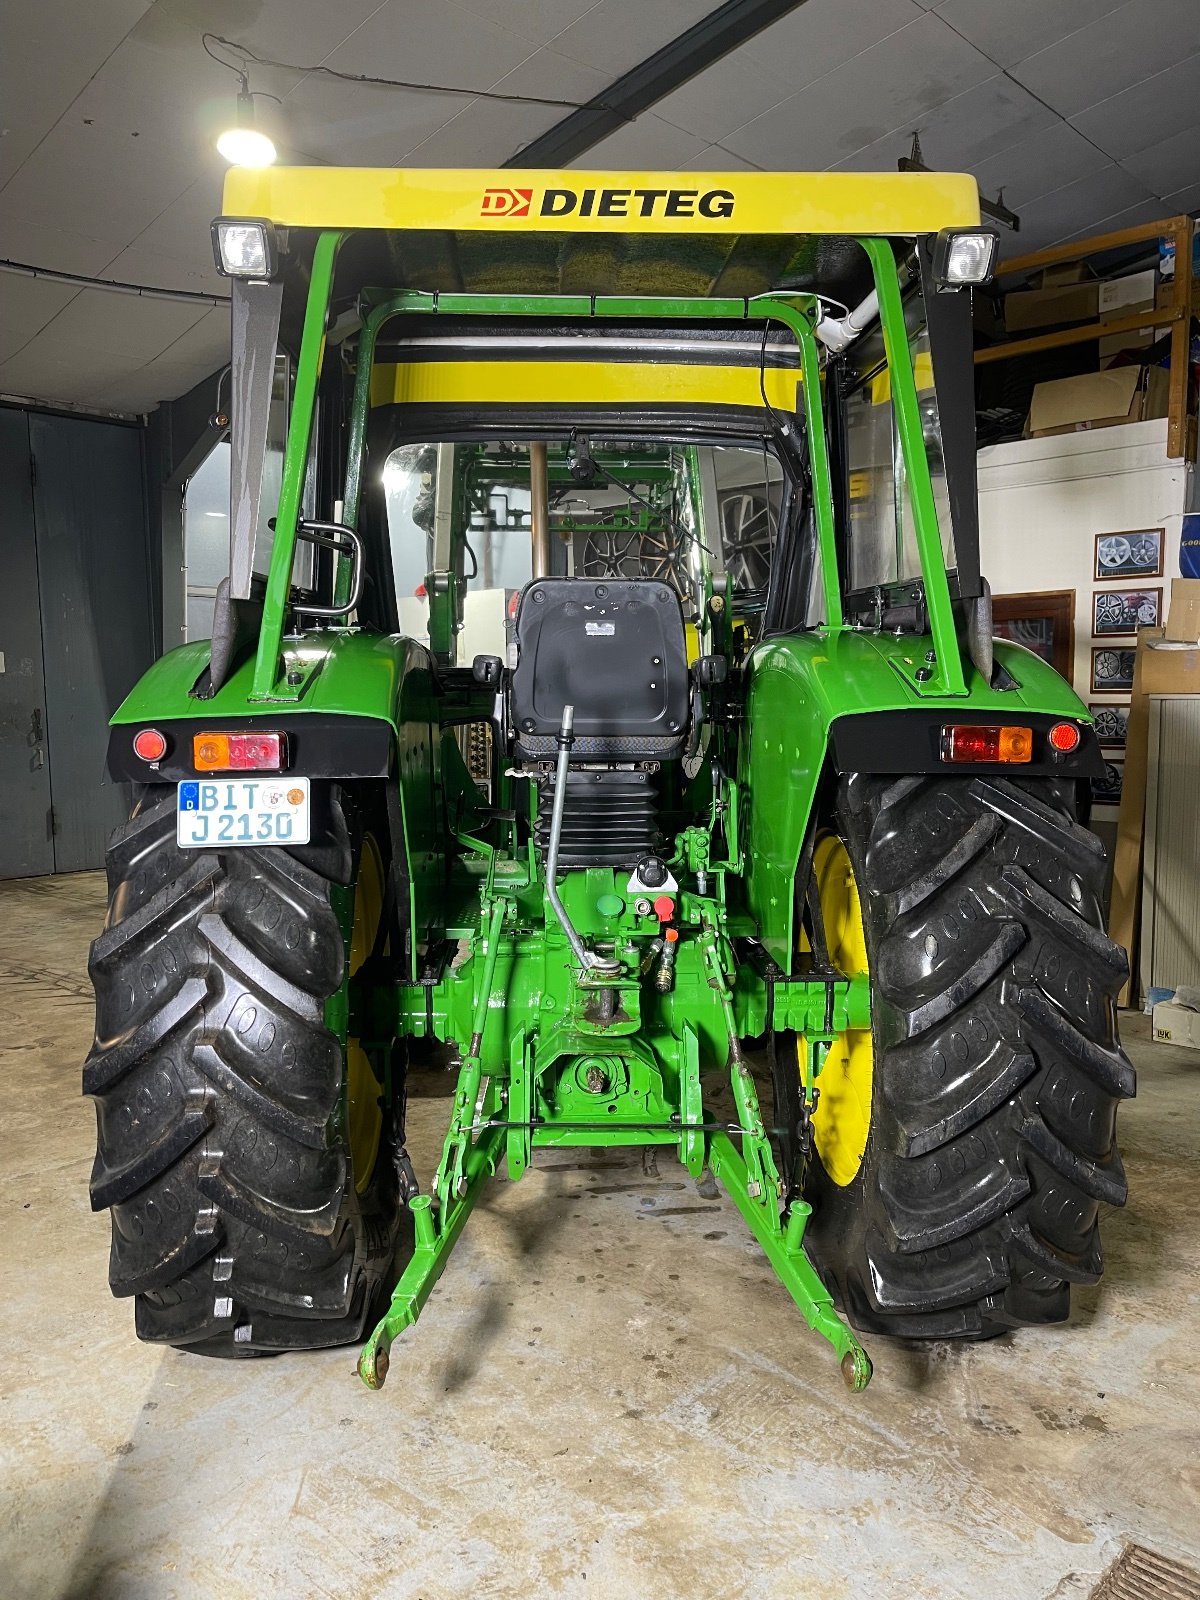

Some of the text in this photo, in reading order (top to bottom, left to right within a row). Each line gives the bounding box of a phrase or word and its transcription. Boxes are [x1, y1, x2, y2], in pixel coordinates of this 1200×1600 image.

[540, 189, 735, 218] DIETEG
[1181, 539, 1200, 547] GOO
[186, 800, 194, 810] D
[201, 784, 260, 811] BIT
[191, 812, 293, 841] J 2130
